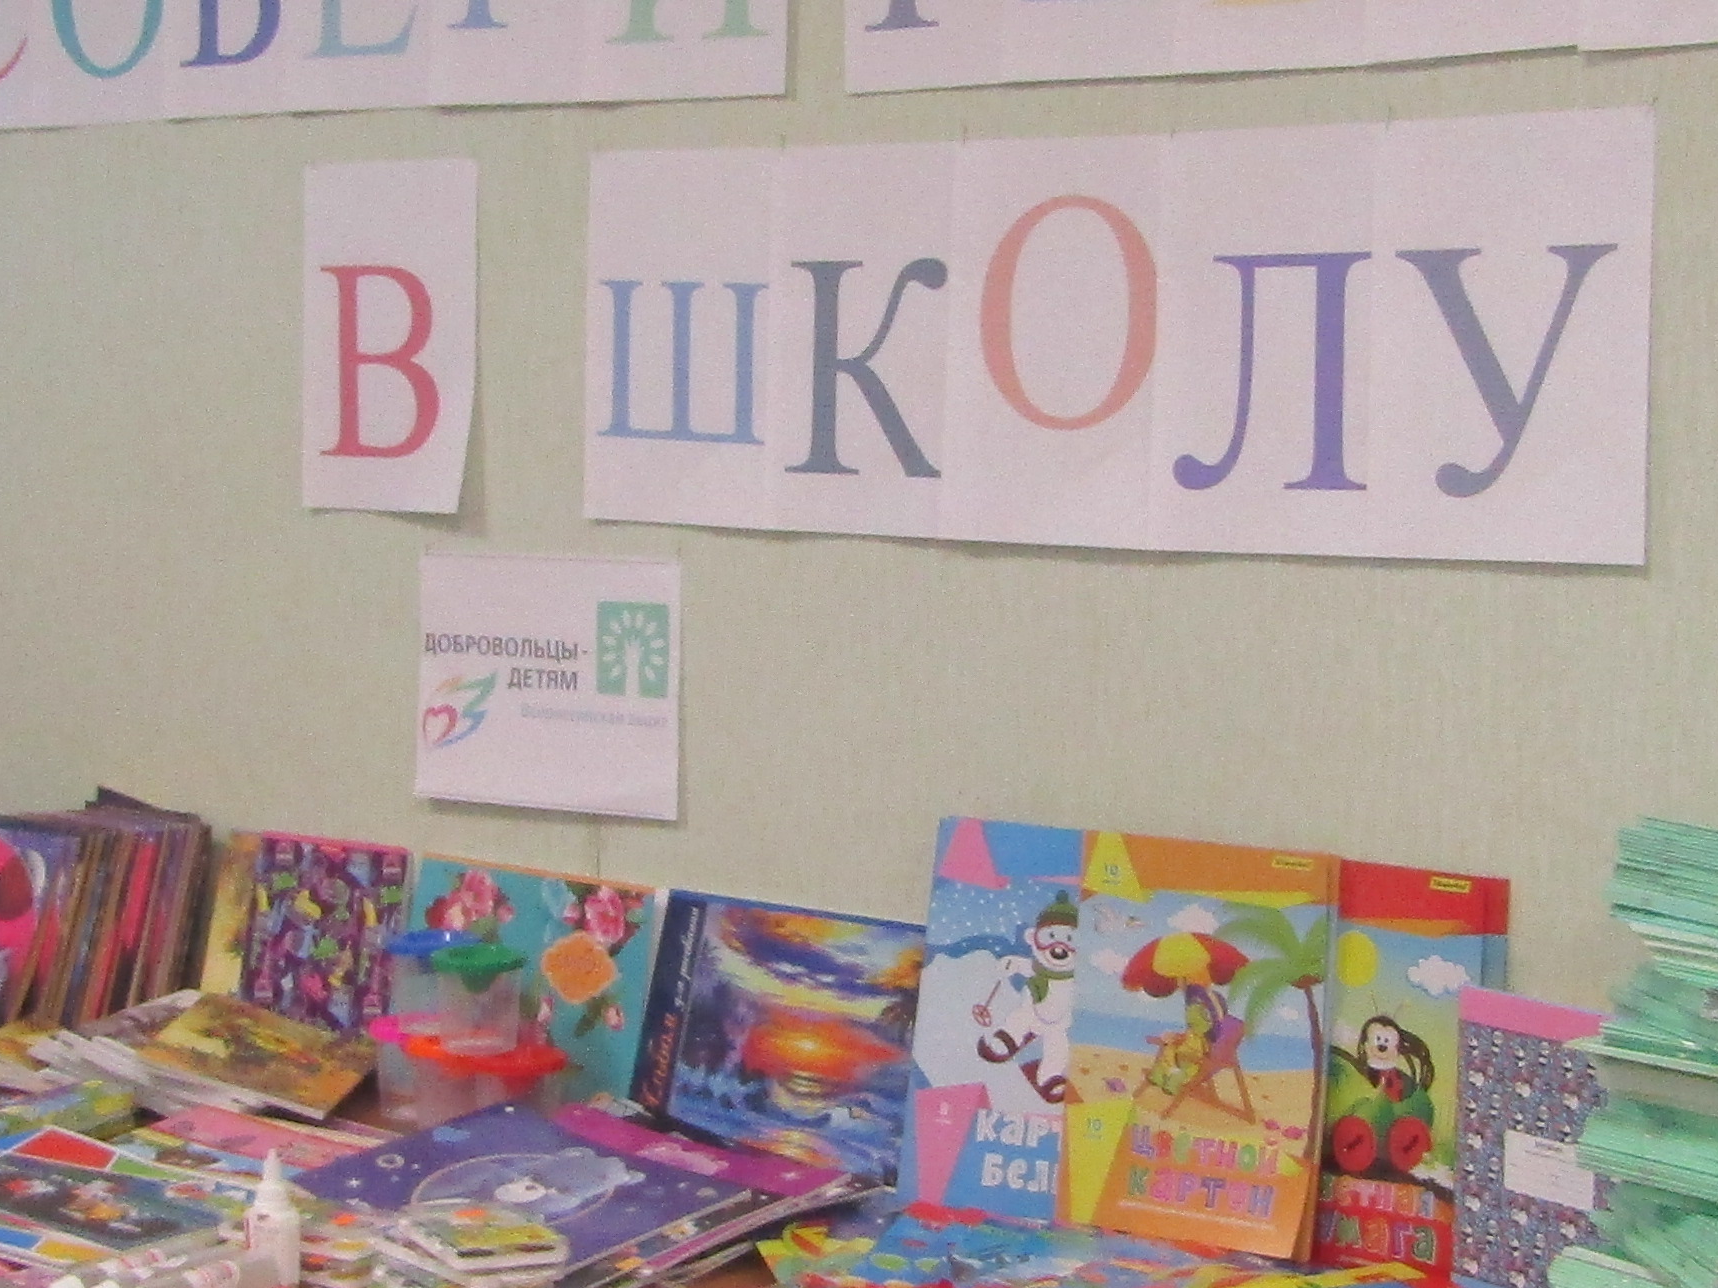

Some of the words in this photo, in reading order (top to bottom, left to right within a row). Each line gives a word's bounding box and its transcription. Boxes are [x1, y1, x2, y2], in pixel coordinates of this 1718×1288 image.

[318, 262, 441, 460] В
[594, 193, 1619, 499] ШКОЛУ
[507, 666, 579, 691] ДЕТЯМ
